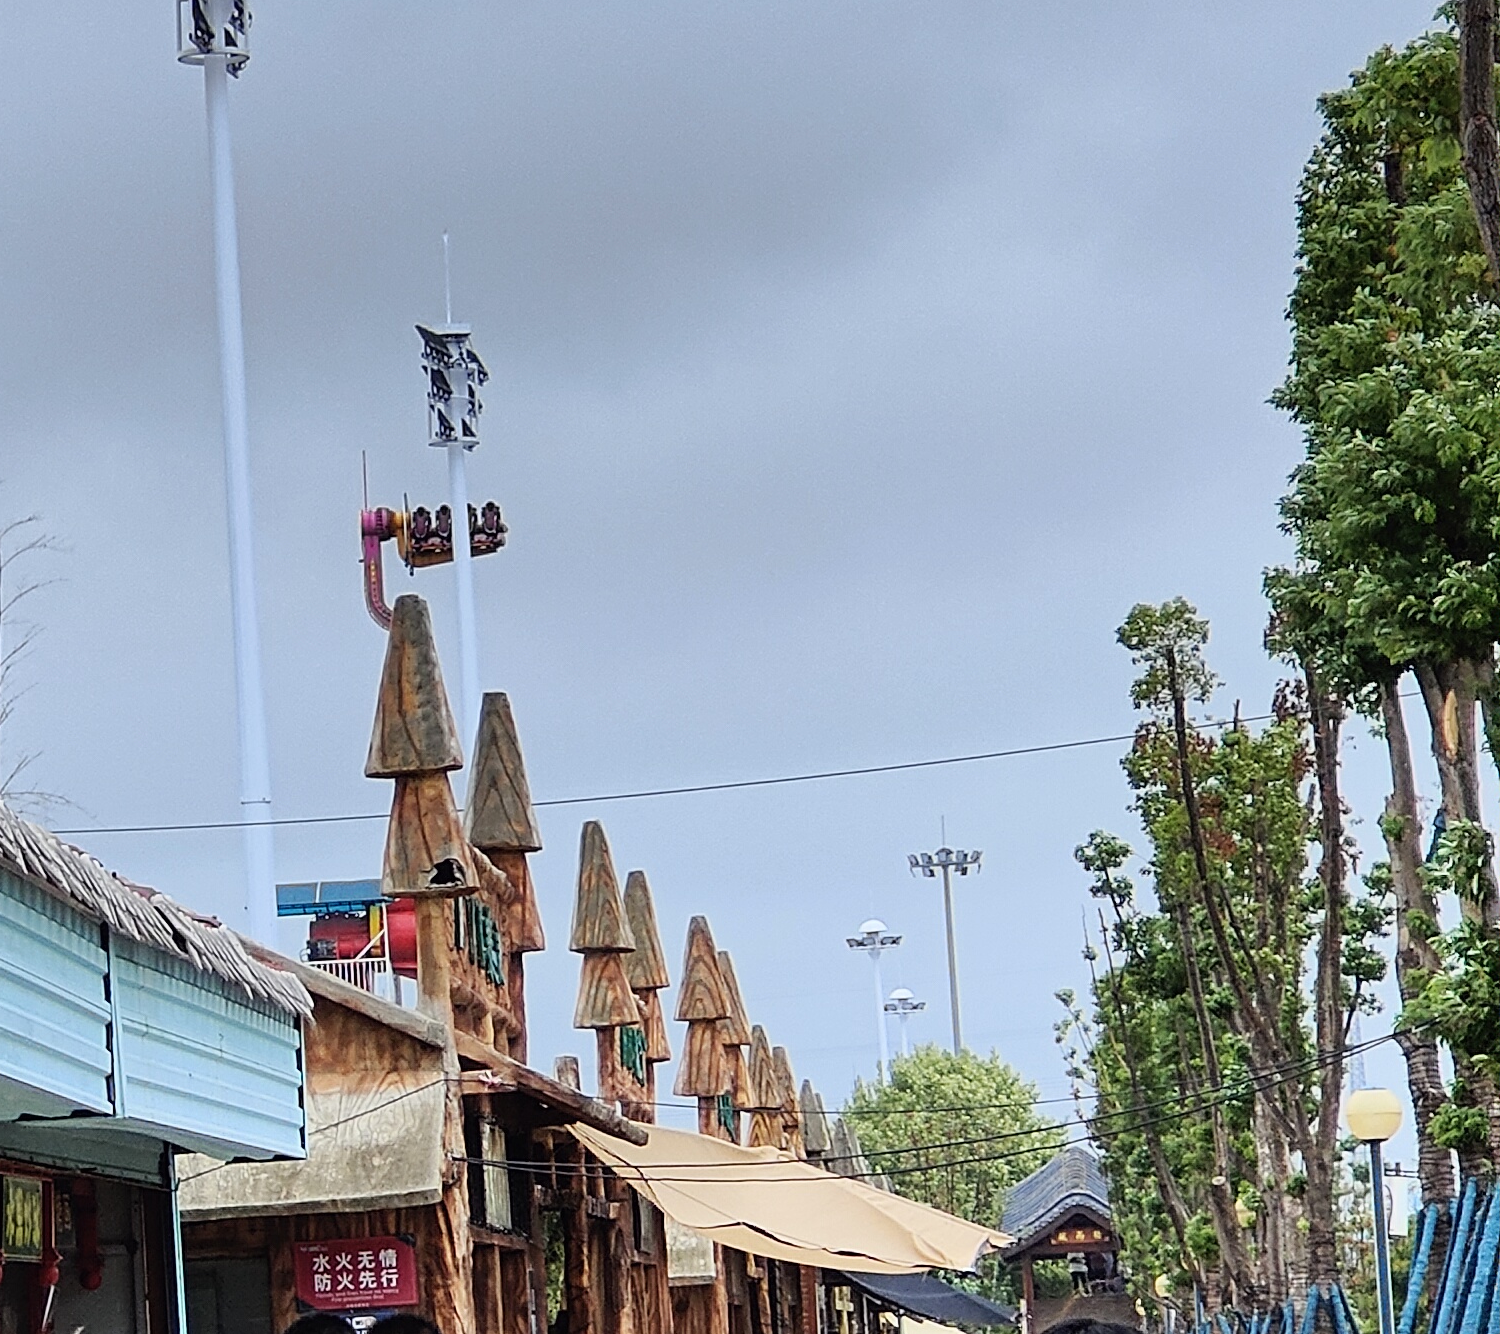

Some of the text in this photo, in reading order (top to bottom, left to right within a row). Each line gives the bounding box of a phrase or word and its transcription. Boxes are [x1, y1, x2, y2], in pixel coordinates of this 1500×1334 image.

[312, 1248, 398, 1273] 水火无情
[314, 1268, 399, 1293] 防火先行
